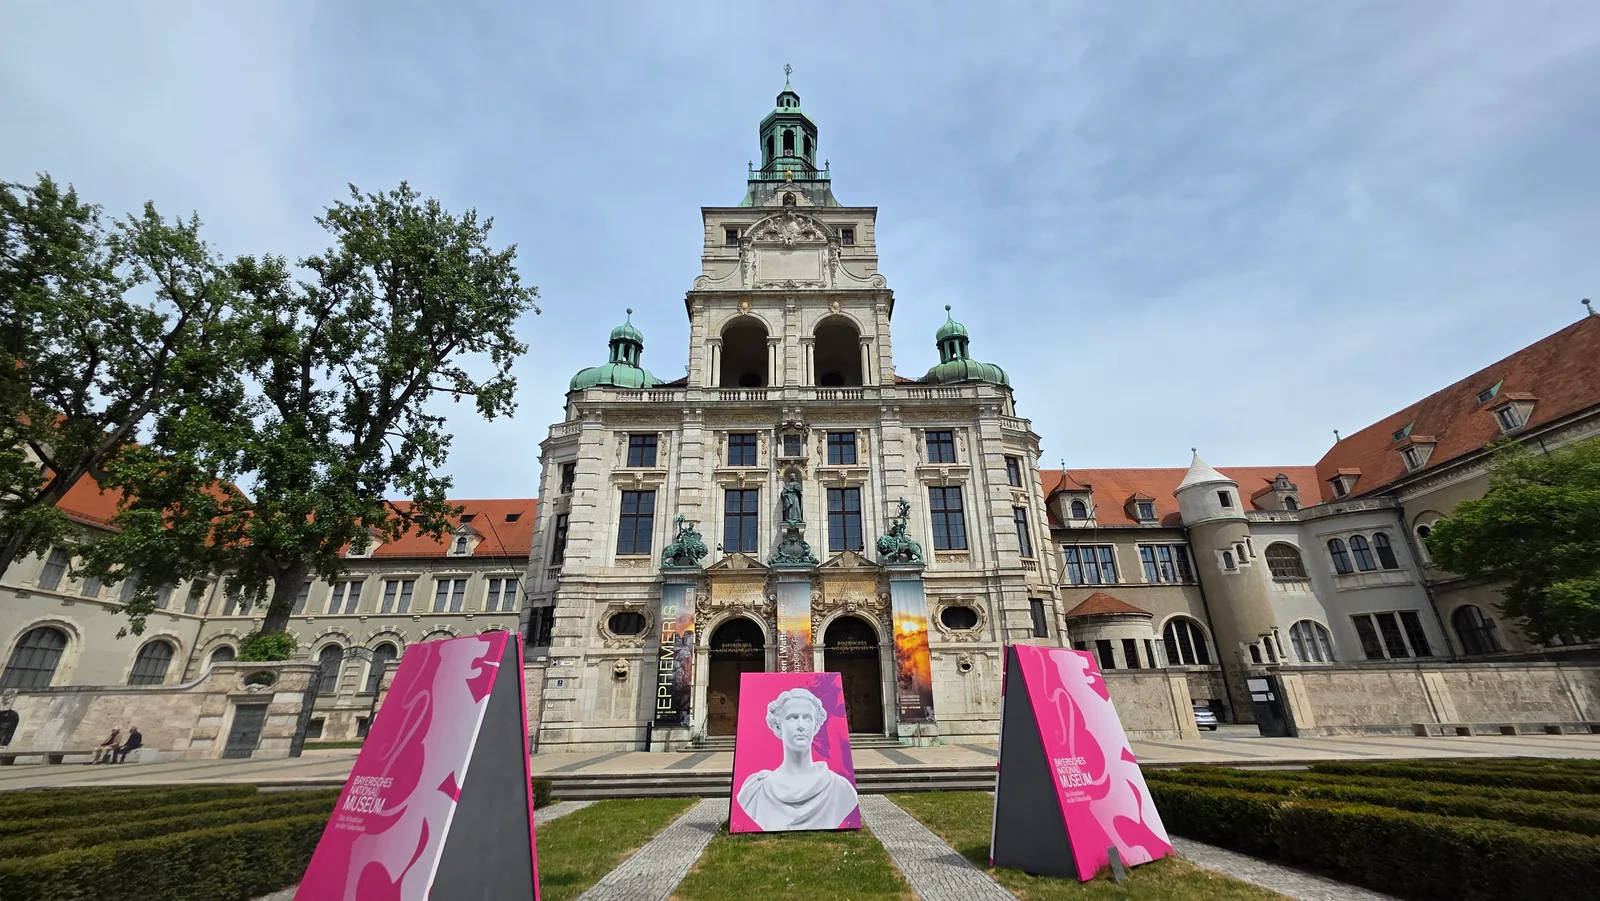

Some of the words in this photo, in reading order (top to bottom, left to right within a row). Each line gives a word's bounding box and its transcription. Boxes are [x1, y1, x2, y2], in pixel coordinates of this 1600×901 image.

[657, 605, 677, 709] EPHEMERIS
[1053, 756, 1087, 767] BAYERISCHES
[1056, 765, 1081, 775] NATIONAL
[353, 775, 394, 788] BAYERISCHES
[1059, 772, 1094, 788] MUSEUM
[349, 785, 381, 797] NATIONAL
[342, 794, 387, 815] MUSEUM
